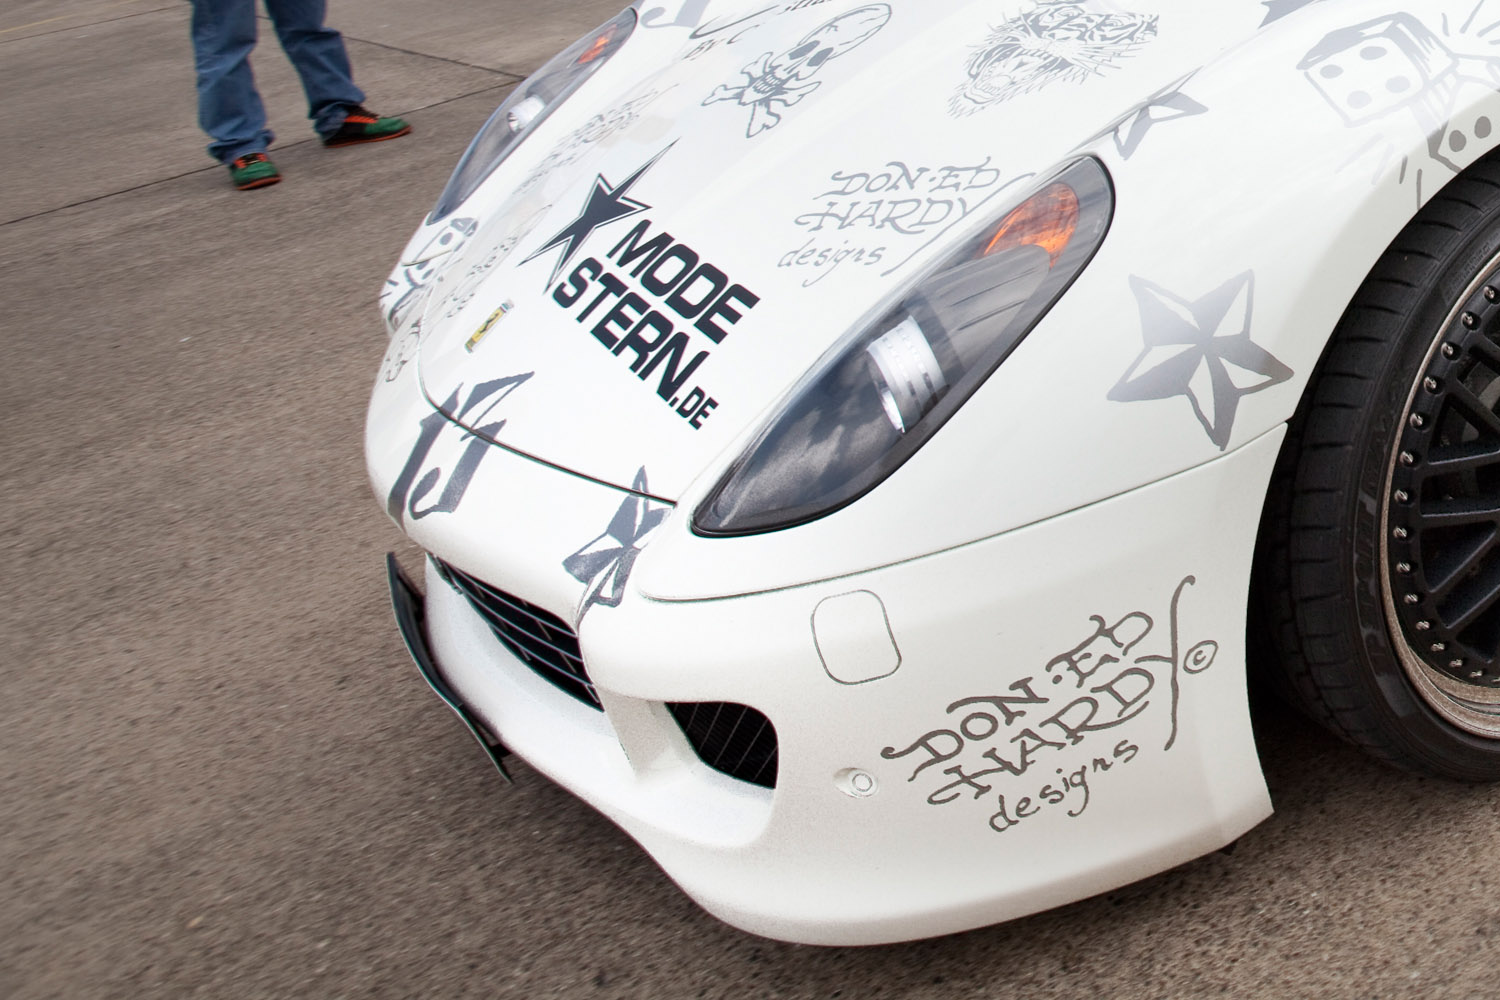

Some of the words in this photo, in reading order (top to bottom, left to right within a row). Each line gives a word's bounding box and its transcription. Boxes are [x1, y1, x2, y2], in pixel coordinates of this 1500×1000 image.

[777, 238, 887, 287] designs
[794, 172, 1036, 277] HARDY
[606, 219, 761, 344] MODE
[927, 575, 1197, 806] HARDY
[989, 739, 1139, 832] designs
